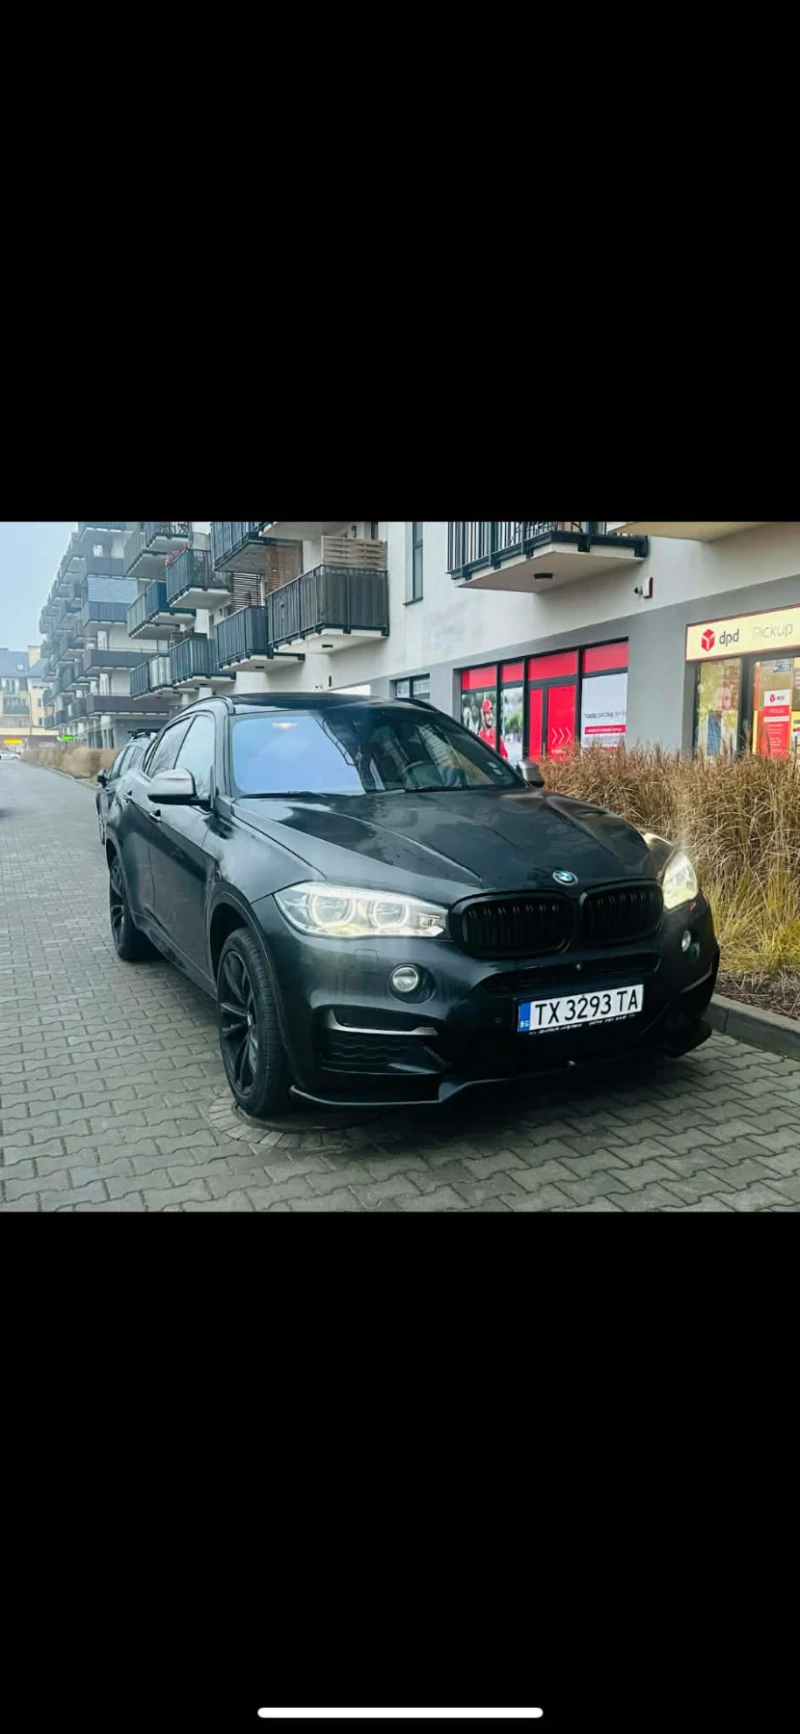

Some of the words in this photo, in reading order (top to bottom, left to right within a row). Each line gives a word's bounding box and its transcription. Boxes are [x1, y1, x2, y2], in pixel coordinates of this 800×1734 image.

[719, 628, 740, 647] dpd
[752, 623, 794, 640] Pickup
[535, 1001, 561, 1026] TX
[564, 994, 612, 1021] 3293
[616, 989, 638, 1013] TA
